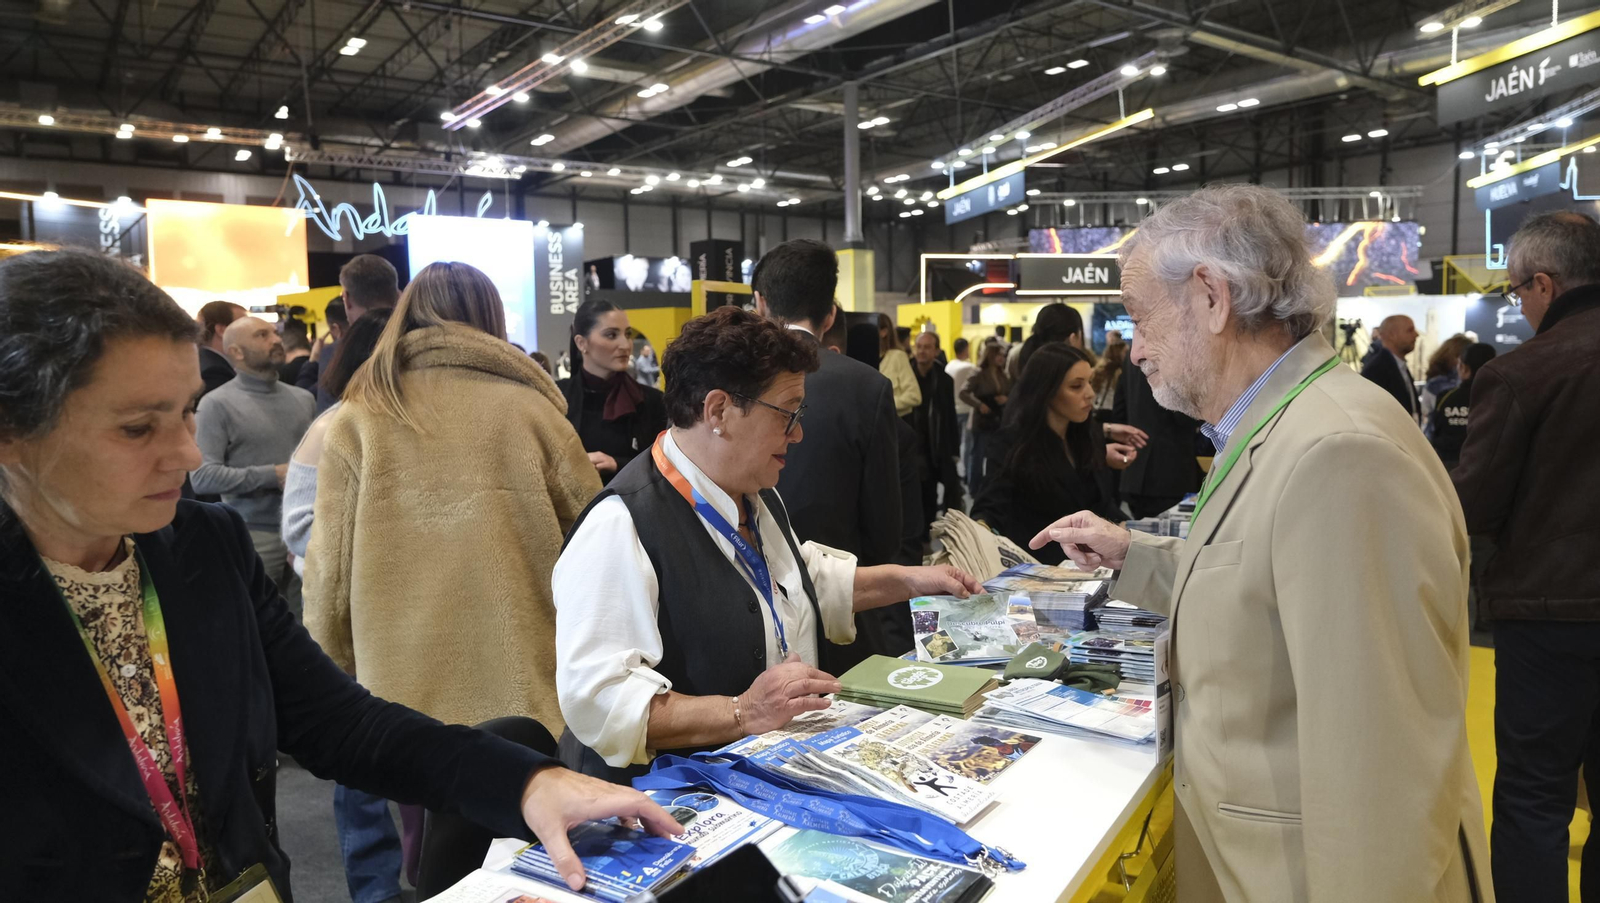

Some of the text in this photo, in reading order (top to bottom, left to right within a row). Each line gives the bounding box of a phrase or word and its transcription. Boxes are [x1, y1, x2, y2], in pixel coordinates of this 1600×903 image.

[1485, 65, 1534, 102] JAÉN
[548, 231, 564, 314] BUSINESS
[1062, 262, 1109, 284] JAÉN
[565, 267, 579, 314] AREA
[1444, 406, 1469, 417] SAS
[674, 812, 727, 841] Explora
[708, 811, 743, 832] submarino
[909, 863, 942, 888] PACK
